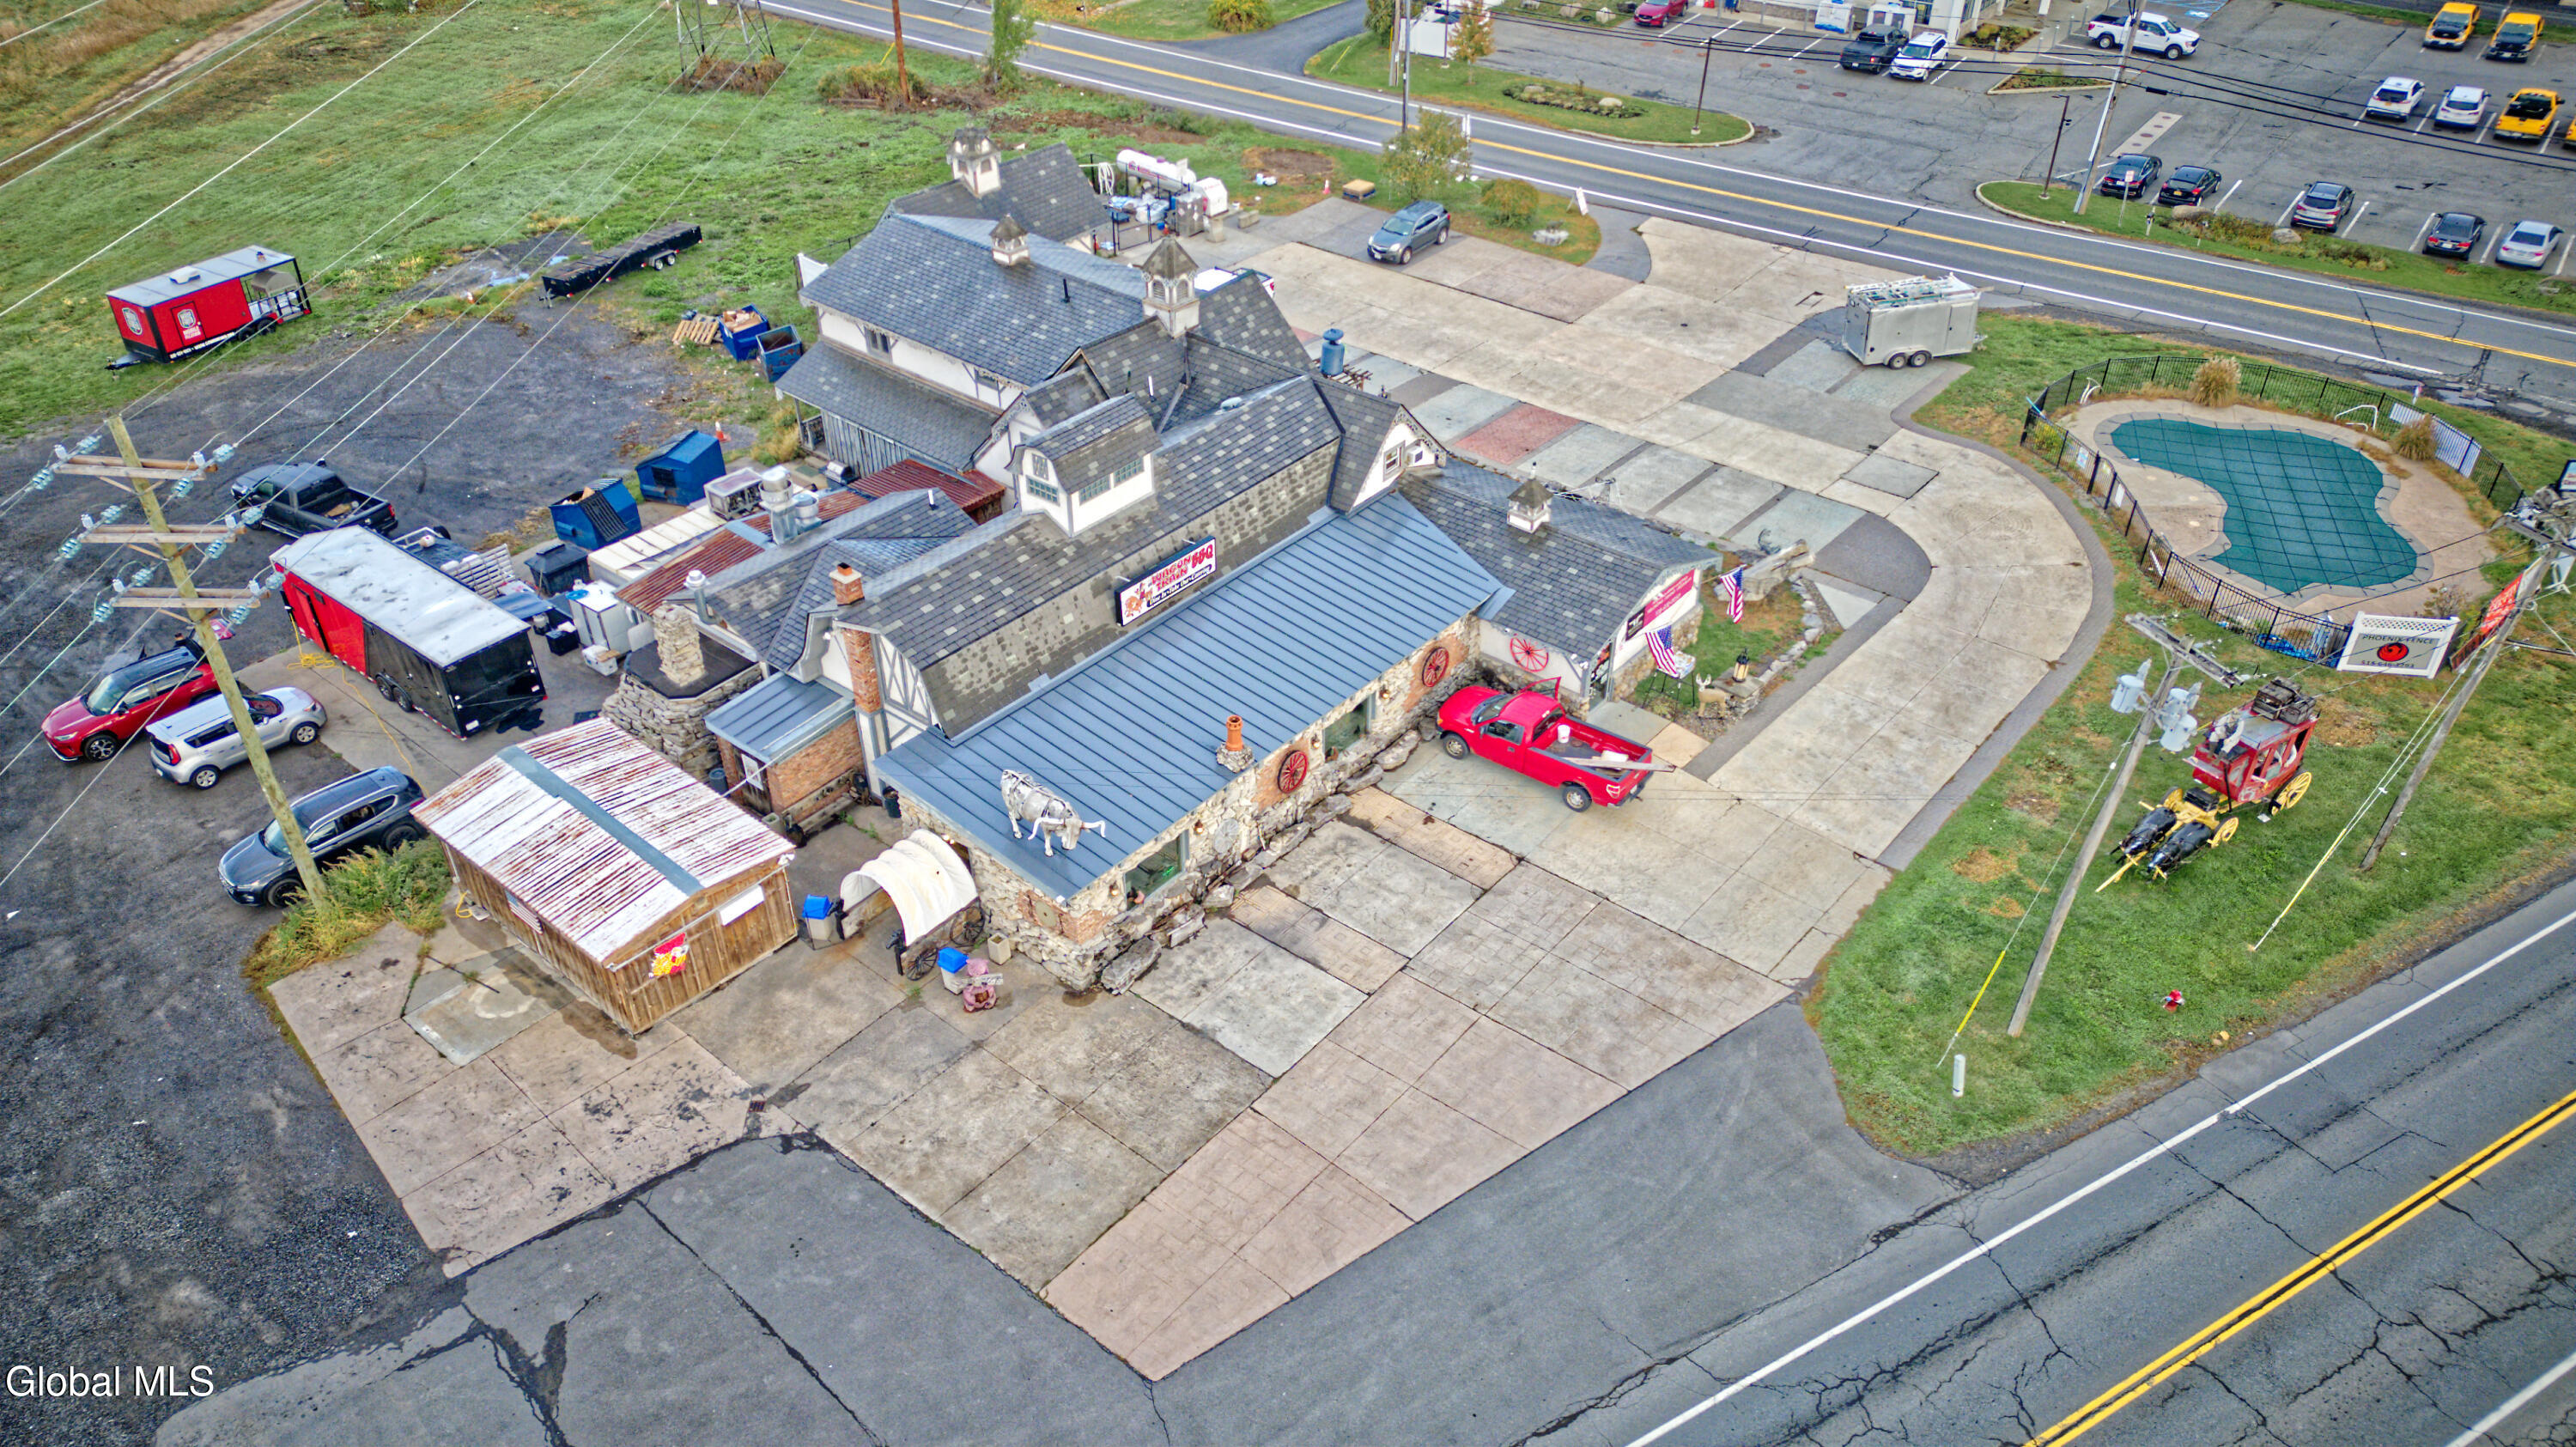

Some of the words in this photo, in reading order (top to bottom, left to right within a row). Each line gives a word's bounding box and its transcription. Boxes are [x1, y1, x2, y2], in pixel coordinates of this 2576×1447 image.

[1192, 544, 1213, 568] BBQ
[1156, 567, 1188, 591] TRAIN
[2362, 634, 2403, 642] PHOENIX
